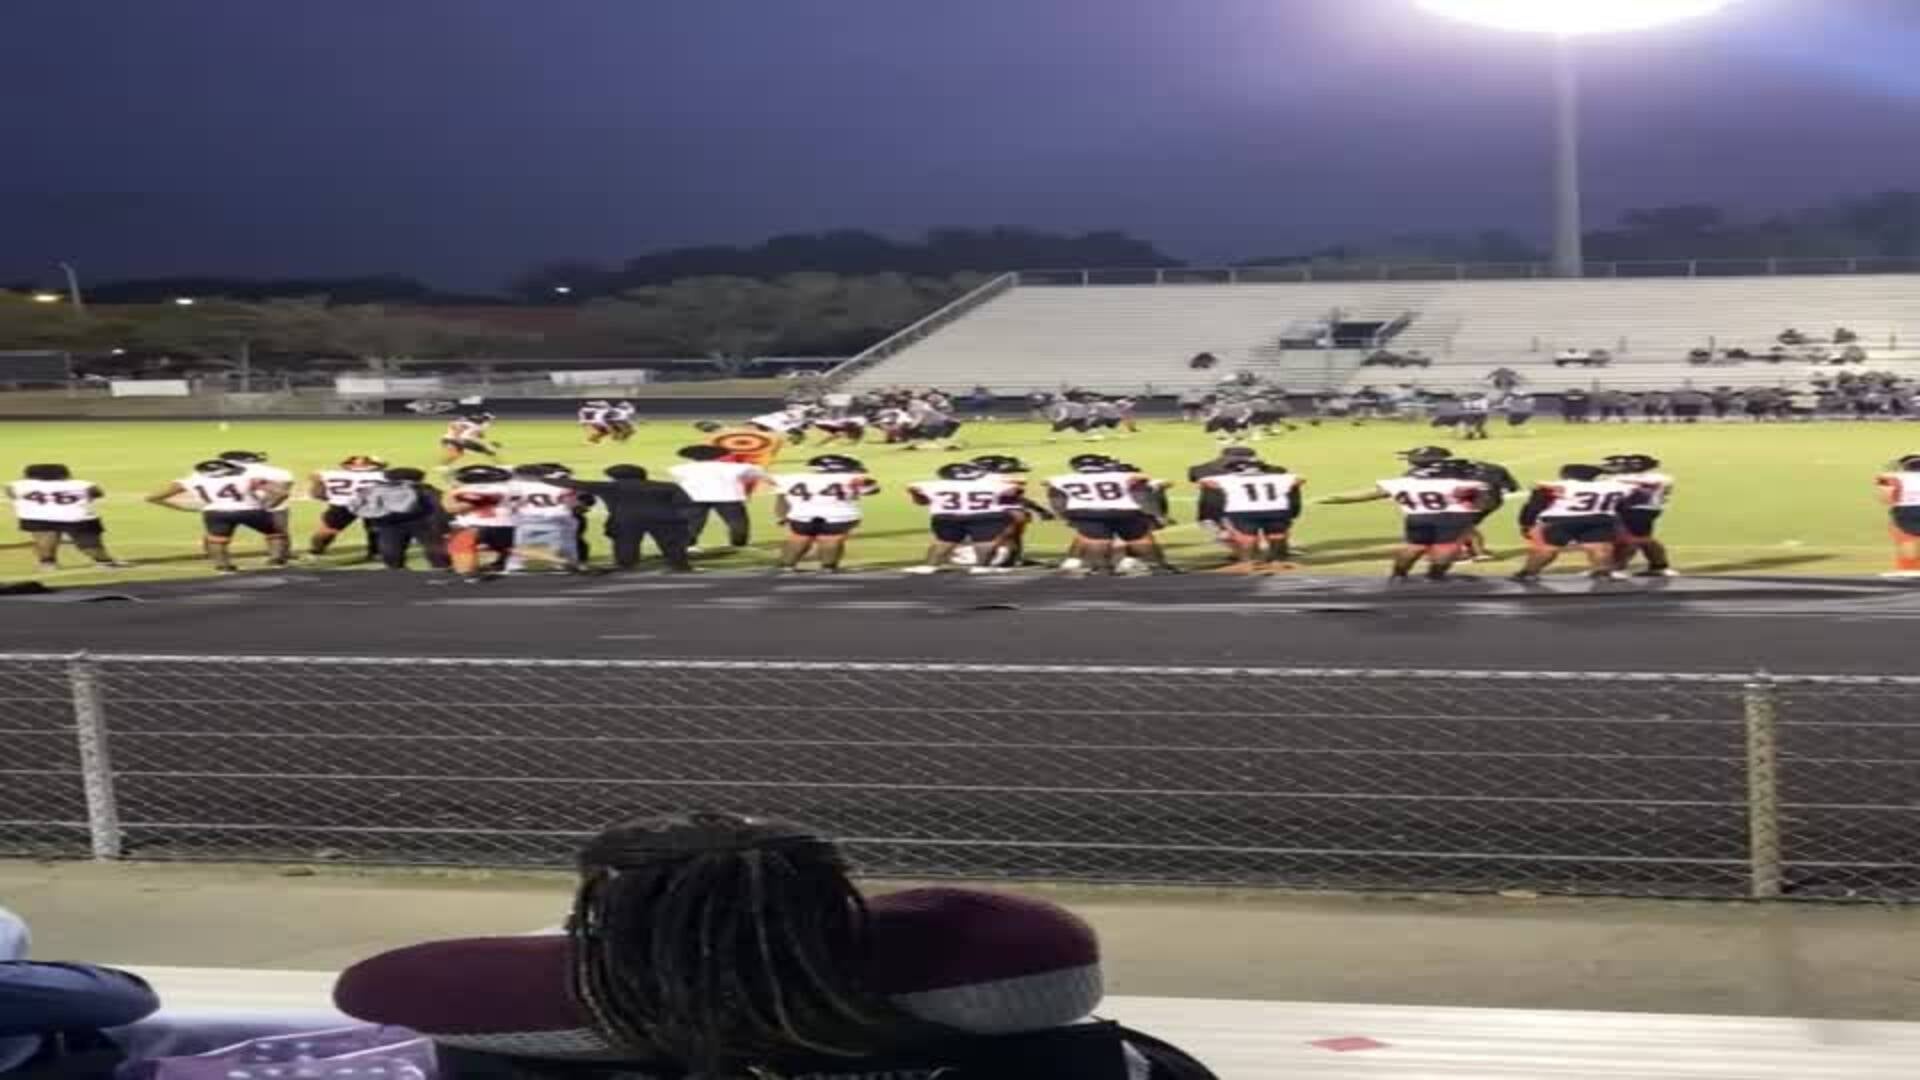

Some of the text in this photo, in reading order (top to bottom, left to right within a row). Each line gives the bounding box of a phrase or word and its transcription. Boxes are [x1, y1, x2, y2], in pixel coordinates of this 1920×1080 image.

[194, 484, 244, 503] 14
[788, 482, 847, 501] 44
[1062, 481, 1122, 500] 28
[1242, 483, 1278, 501] 11
[936, 491, 993, 510] 35
[1395, 491, 1448, 510] 48
